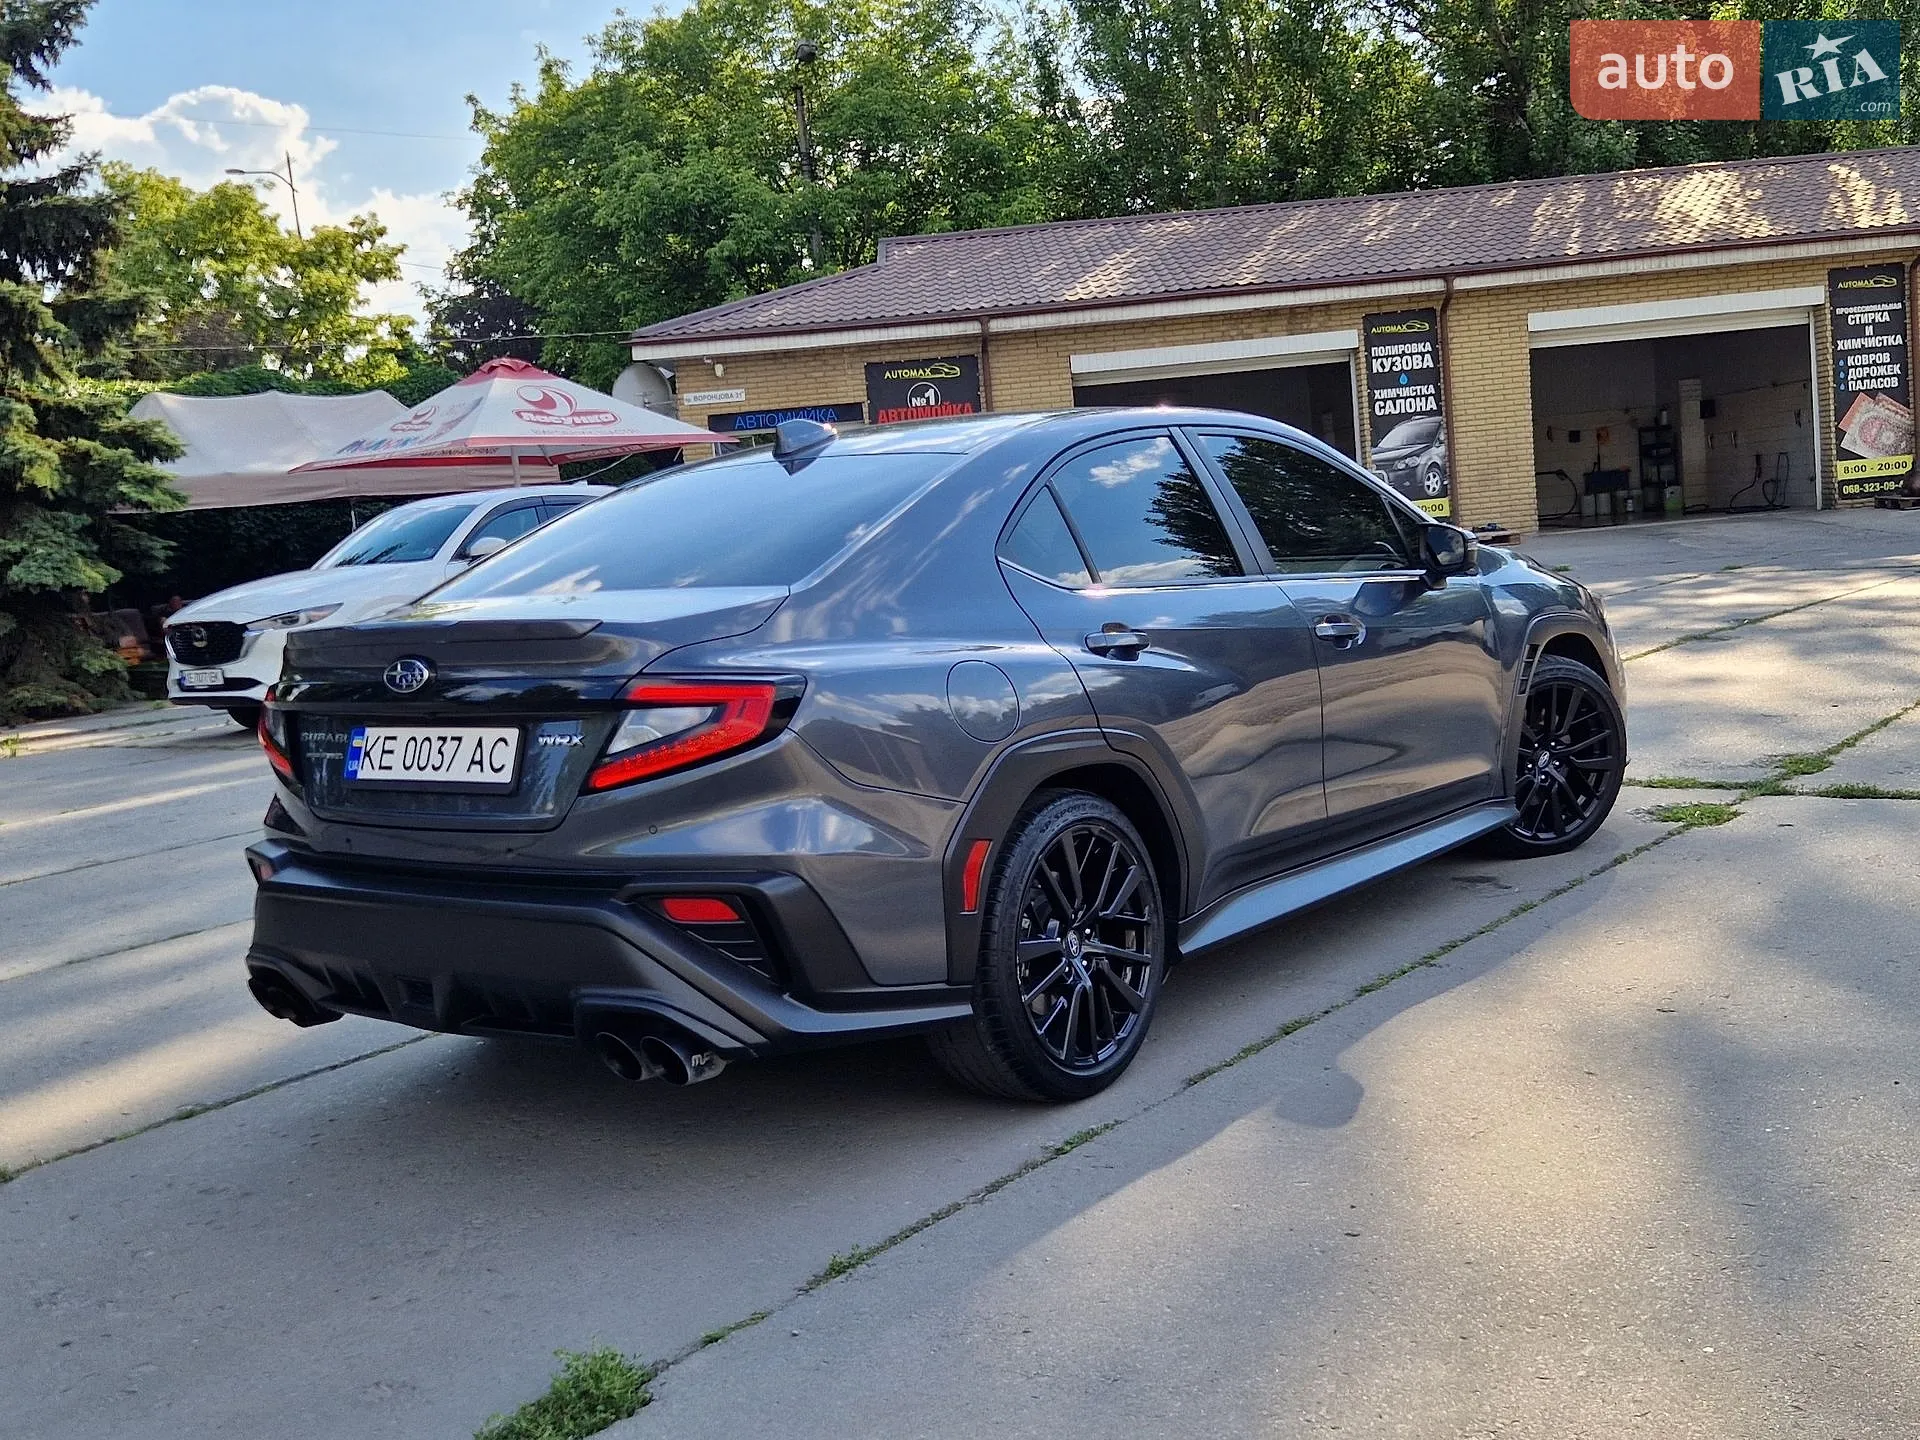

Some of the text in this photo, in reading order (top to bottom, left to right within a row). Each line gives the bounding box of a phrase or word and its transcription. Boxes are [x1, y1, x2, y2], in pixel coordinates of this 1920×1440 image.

[1837, 279, 1875, 289] AUTOMAX
[1835, 302, 1902, 315] ПРОФЕССИОНАЛЬНАЯ
[1847, 311, 1891, 325] СТИРКА
[1371, 324, 1407, 334] AUTOMAX
[1865, 325, 1874, 336] И
[1371, 341, 1432, 357] ПОЛИРОВКА
[1836, 334, 1903, 351] ХИМЧИСТКА
[1372, 353, 1434, 373] КУЗОВА
[1847, 352, 1891, 366] КОВРОВ
[884, 367, 932, 380] AUTOMAX
[1848, 363, 1902, 380] ДОРОЖЕК
[1848, 377, 1899, 391] ПАЛАСОВ
[1373, 384, 1435, 400] ХИМЧИСТКА
[878, 401, 973, 424] АВТОМОЙКА
[1374, 396, 1437, 416] САЛОНА
[1843, 464, 1867, 474] 8:00
[1877, 461, 1908, 471] 20:00
[538, 734, 586, 747] WRX
[361, 735, 510, 773] KE 0037 AC
